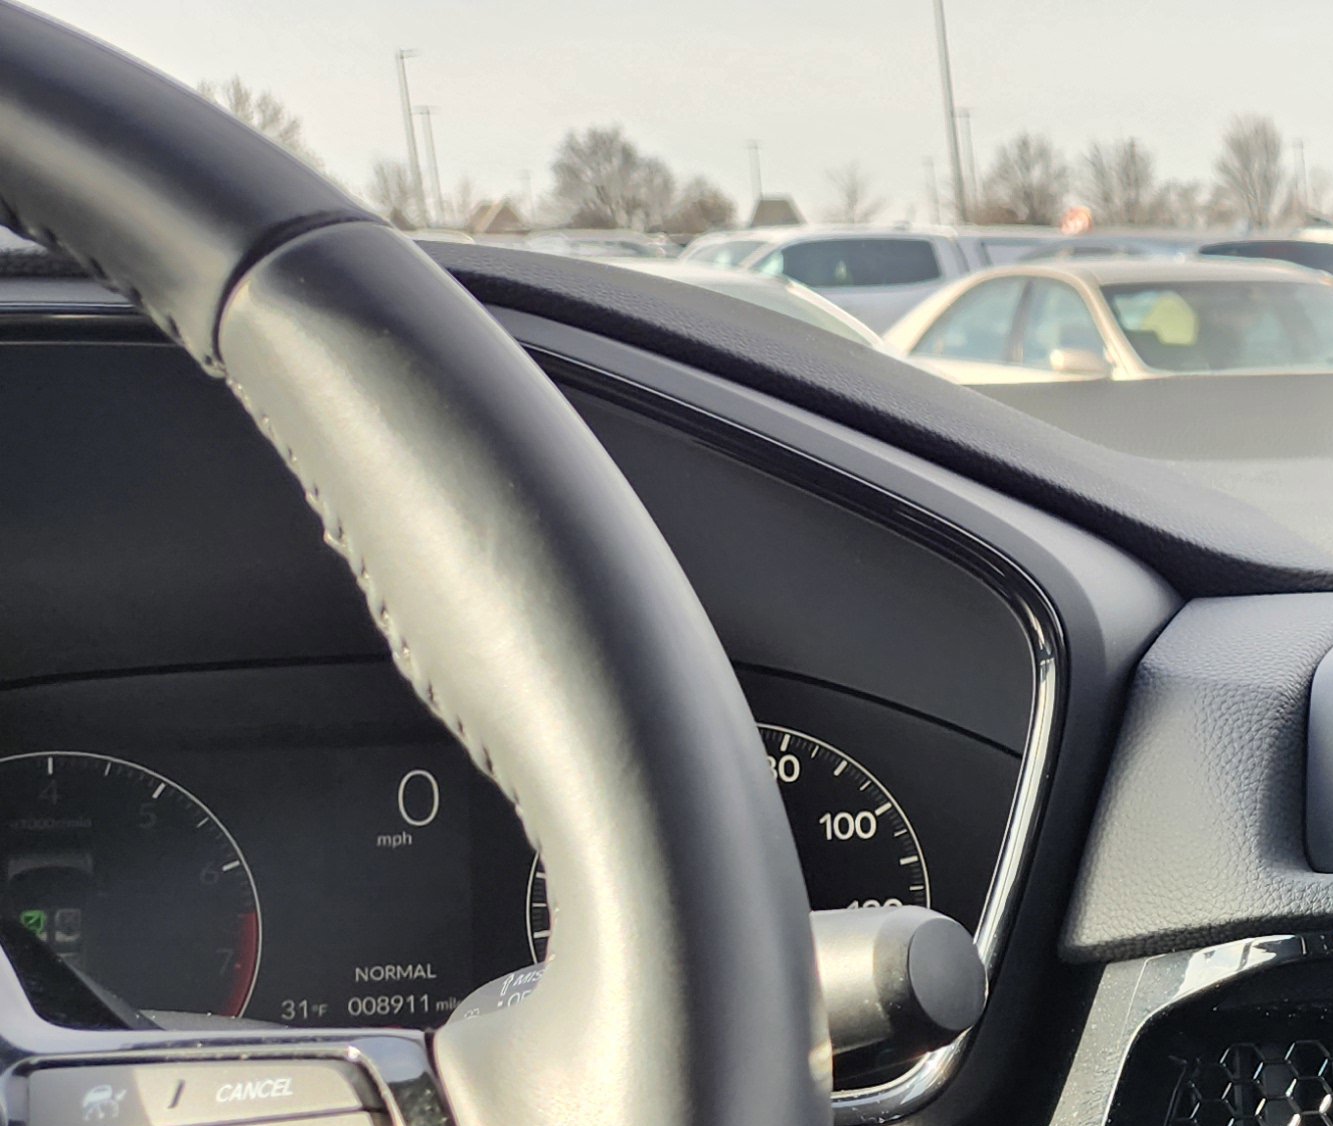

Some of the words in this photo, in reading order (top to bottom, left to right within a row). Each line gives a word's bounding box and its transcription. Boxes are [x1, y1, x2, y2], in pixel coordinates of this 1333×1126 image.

[398, 769, 440, 827] 0
[818, 810, 878, 841] 100
[377, 830, 413, 849] mph
[354, 963, 438, 983] NORMAL
[348, 994, 431, 1017] 008911
[435, 996, 461, 1013] mil
[216, 1077, 294, 1103] CANCEL
